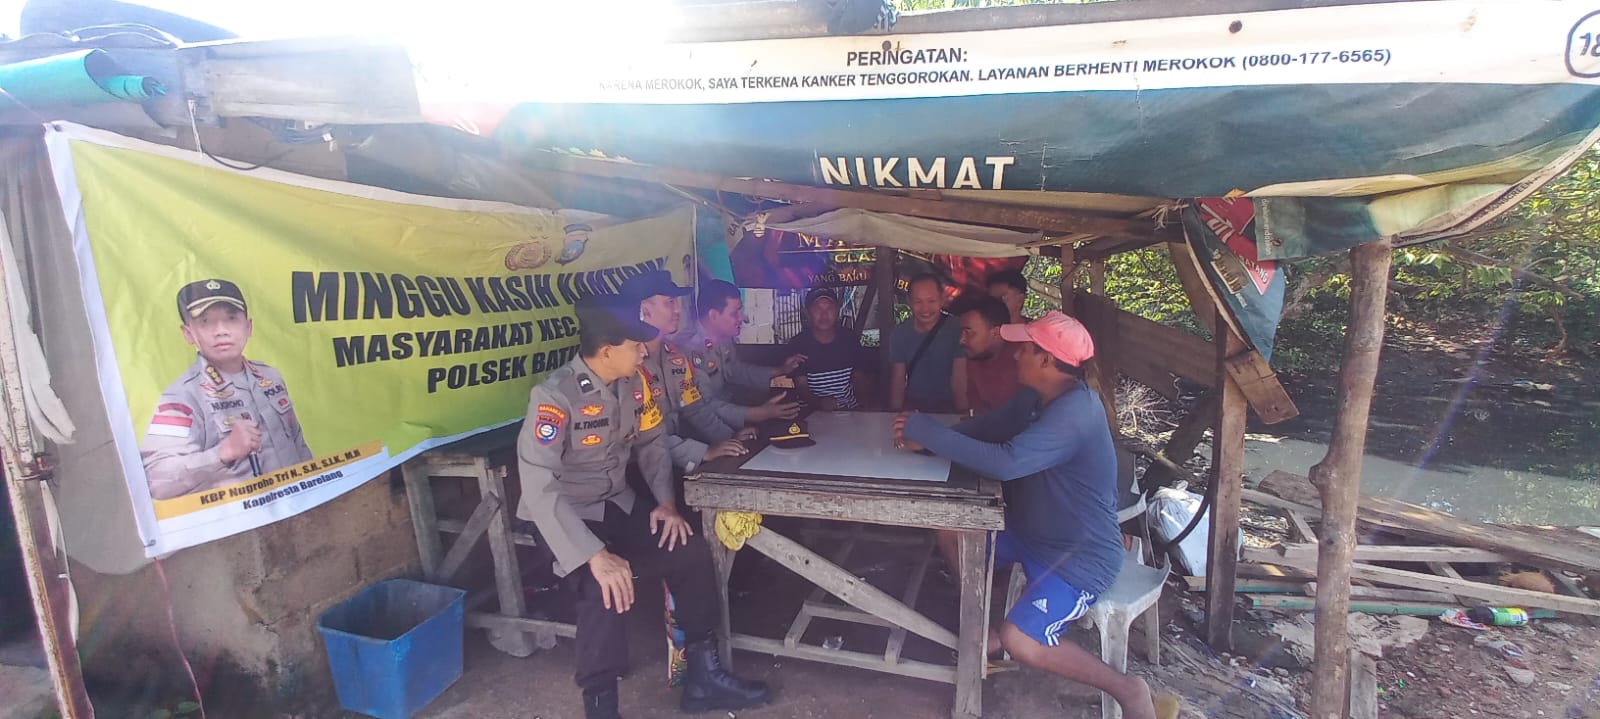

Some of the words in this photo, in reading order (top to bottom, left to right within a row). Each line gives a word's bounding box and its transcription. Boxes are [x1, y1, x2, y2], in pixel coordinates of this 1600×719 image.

[599, 78, 643, 91] KARENA
[645, 77, 706, 92] MEROKOK,
[708, 77, 738, 90] SAYA
[741, 75, 798, 89] TERKENA
[801, 73, 856, 88] KANKER
[859, 70, 974, 86] TENGGOROKAN.
[978, 66, 1049, 82] LAYANAN
[1053, 59, 1139, 78] BERHENTI
[1143, 55, 1236, 72] MEROKOK
[1241, 48, 1393, 71] (0800-177-6565)
[846, 47, 968, 67] PERINGATAN:
[818, 156, 1015, 190] NIKMAT
[291, 270, 472, 324] MINGGU
[463, 272, 560, 313] KASIH
[807, 273, 835, 283] YANG
[332, 319, 534, 368] MASYARAKAT
[540, 316, 581, 343] KEC.
[427, 355, 527, 393] POLSEK
[200, 490, 226, 505] KBP
[229, 477, 275, 497] Nugroho
[275, 472, 289, 483] Tri
[243, 486, 300, 510] Kapolresta
[299, 470, 344, 490] Barelang
